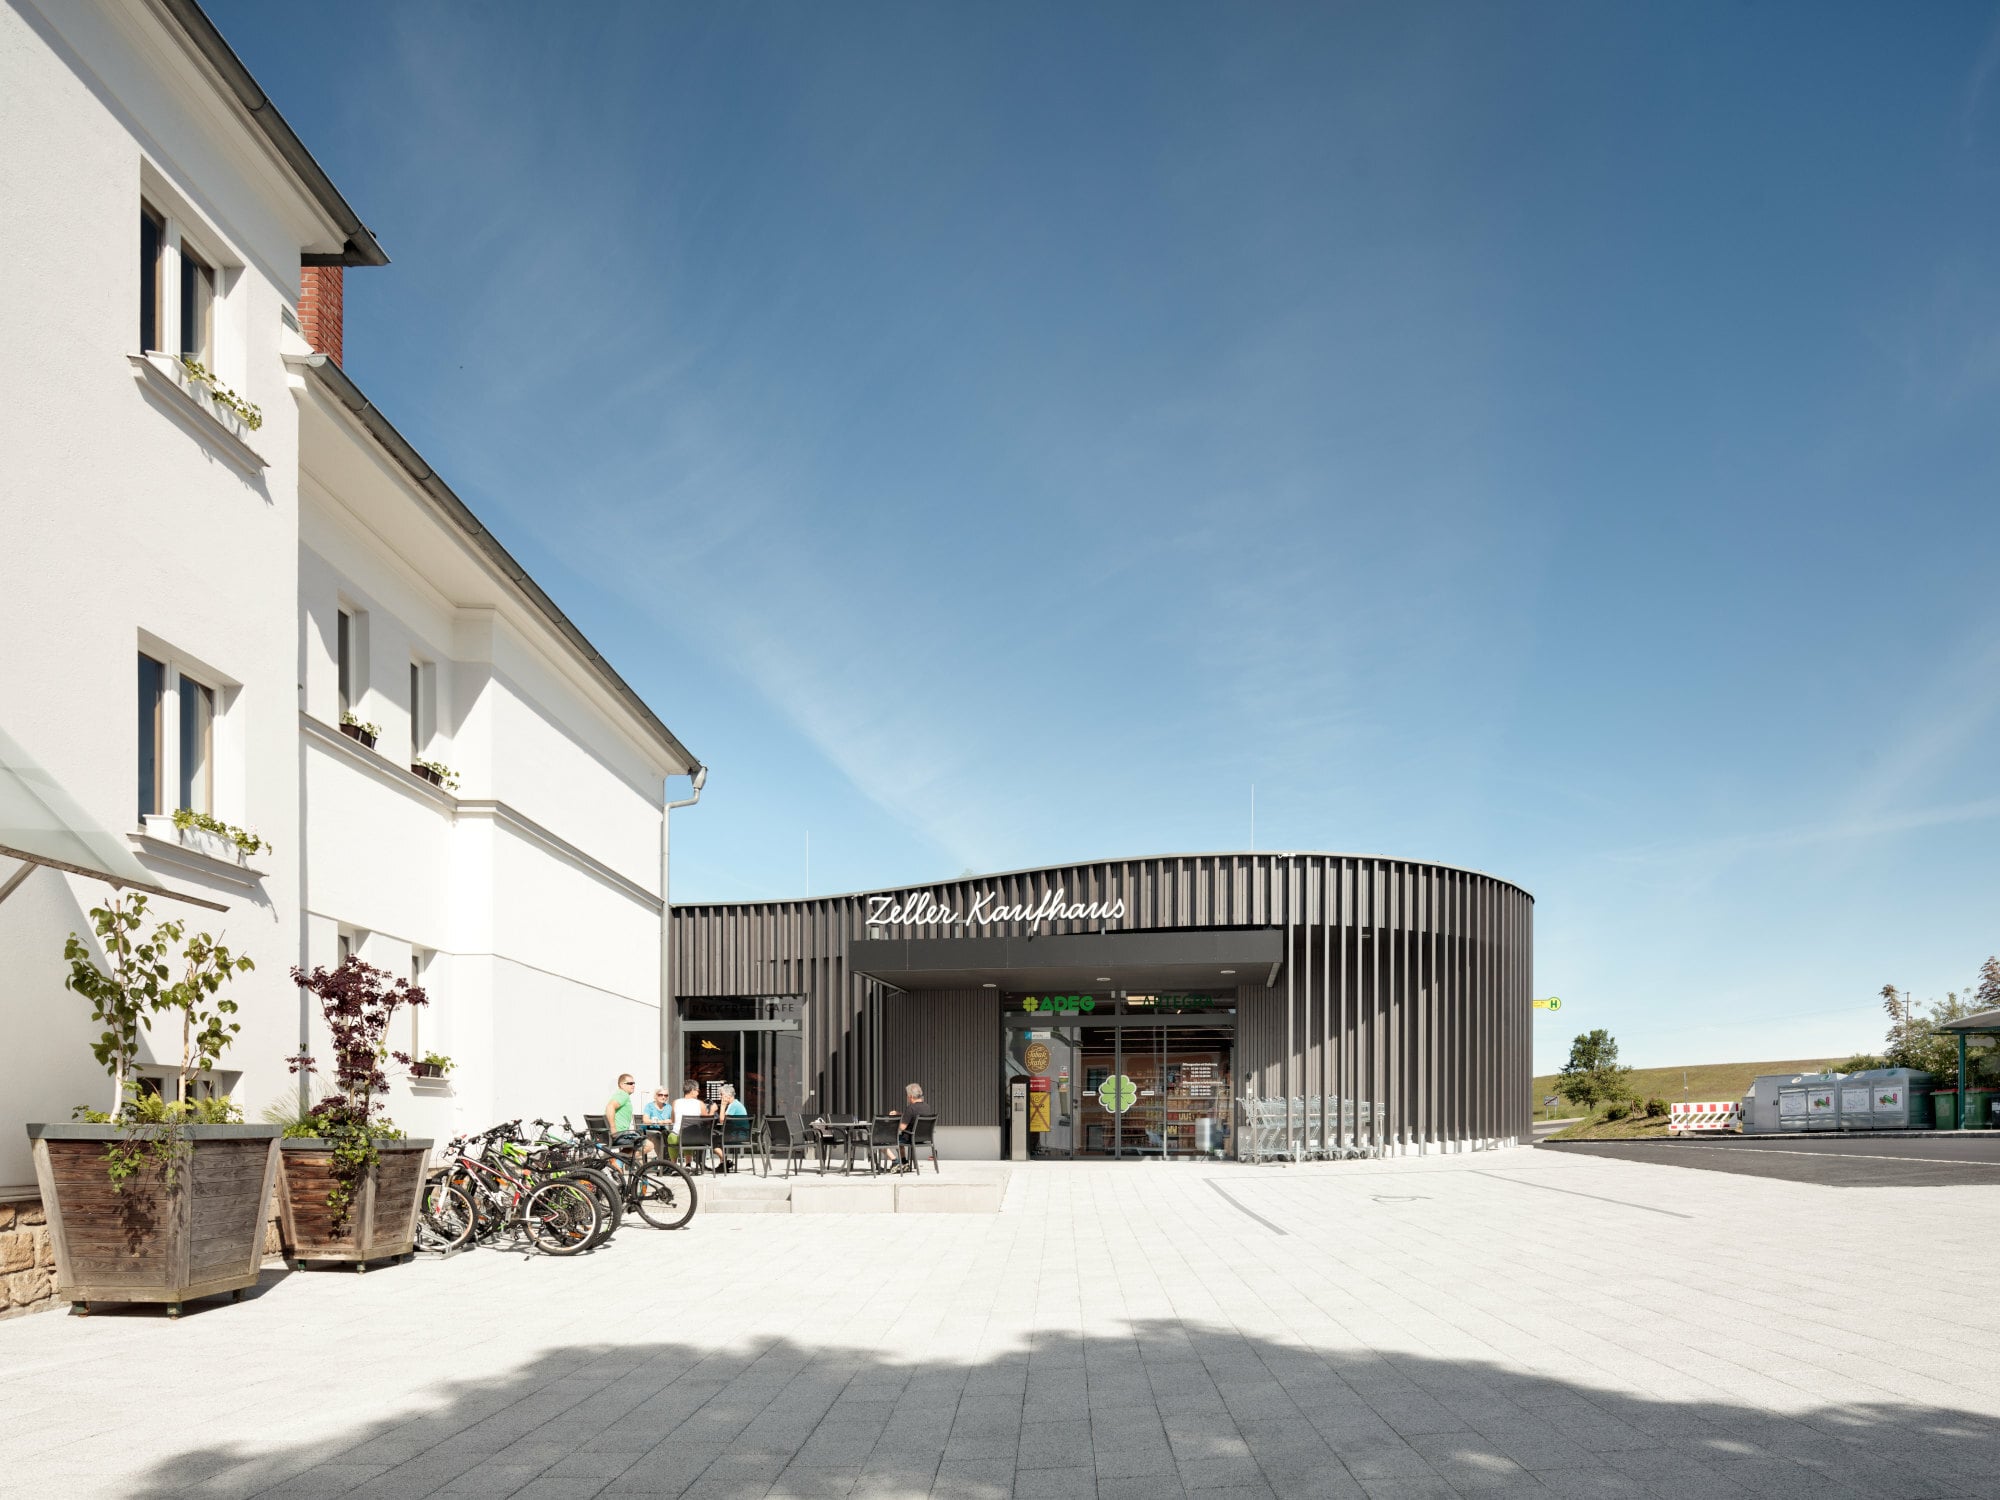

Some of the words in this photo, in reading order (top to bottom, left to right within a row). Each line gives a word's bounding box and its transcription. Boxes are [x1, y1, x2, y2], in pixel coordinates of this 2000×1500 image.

[865, 891, 958, 925] Zeller
[966, 888, 1126, 932] Kaufhaus
[1038, 995, 1096, 1012] ADEG
[1550, 1000, 1558, 1008] H
